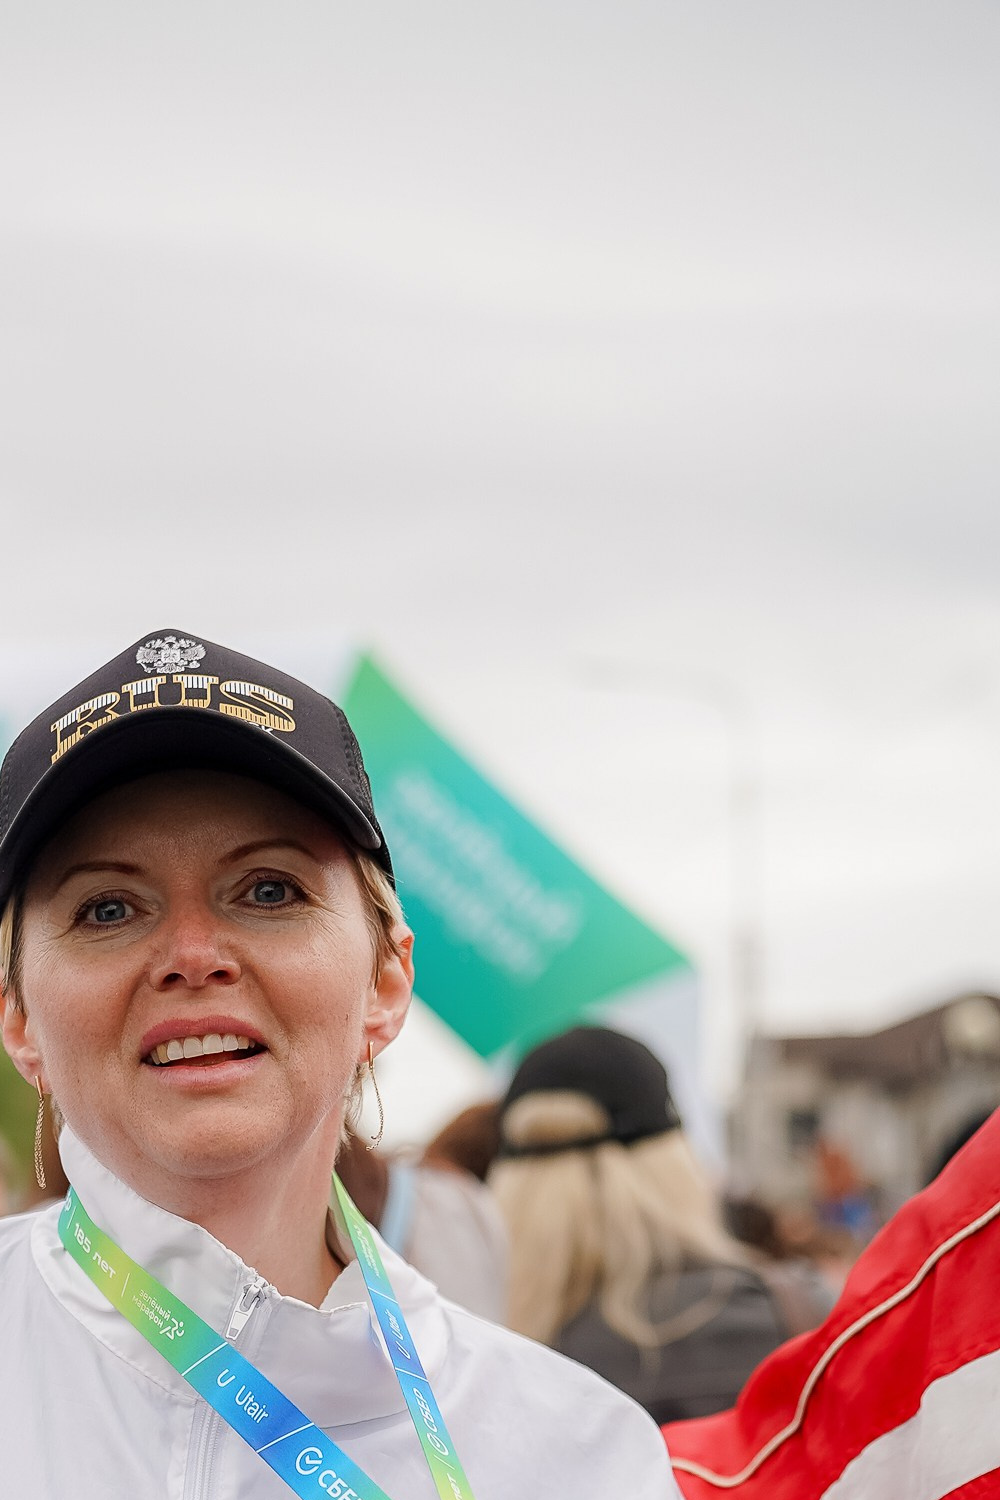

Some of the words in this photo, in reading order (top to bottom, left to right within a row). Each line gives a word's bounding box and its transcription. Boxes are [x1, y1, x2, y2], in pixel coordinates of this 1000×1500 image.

[51, 674, 296, 764] RUS
[74, 1223, 92, 1254] 185
[92, 1253, 117, 1279] лет
[131, 1294, 164, 1328] марафон
[138, 1289, 172, 1321] зелёный
[235, 1385, 269, 1424] Utair
[413, 1387, 438, 1433] СБЕР
